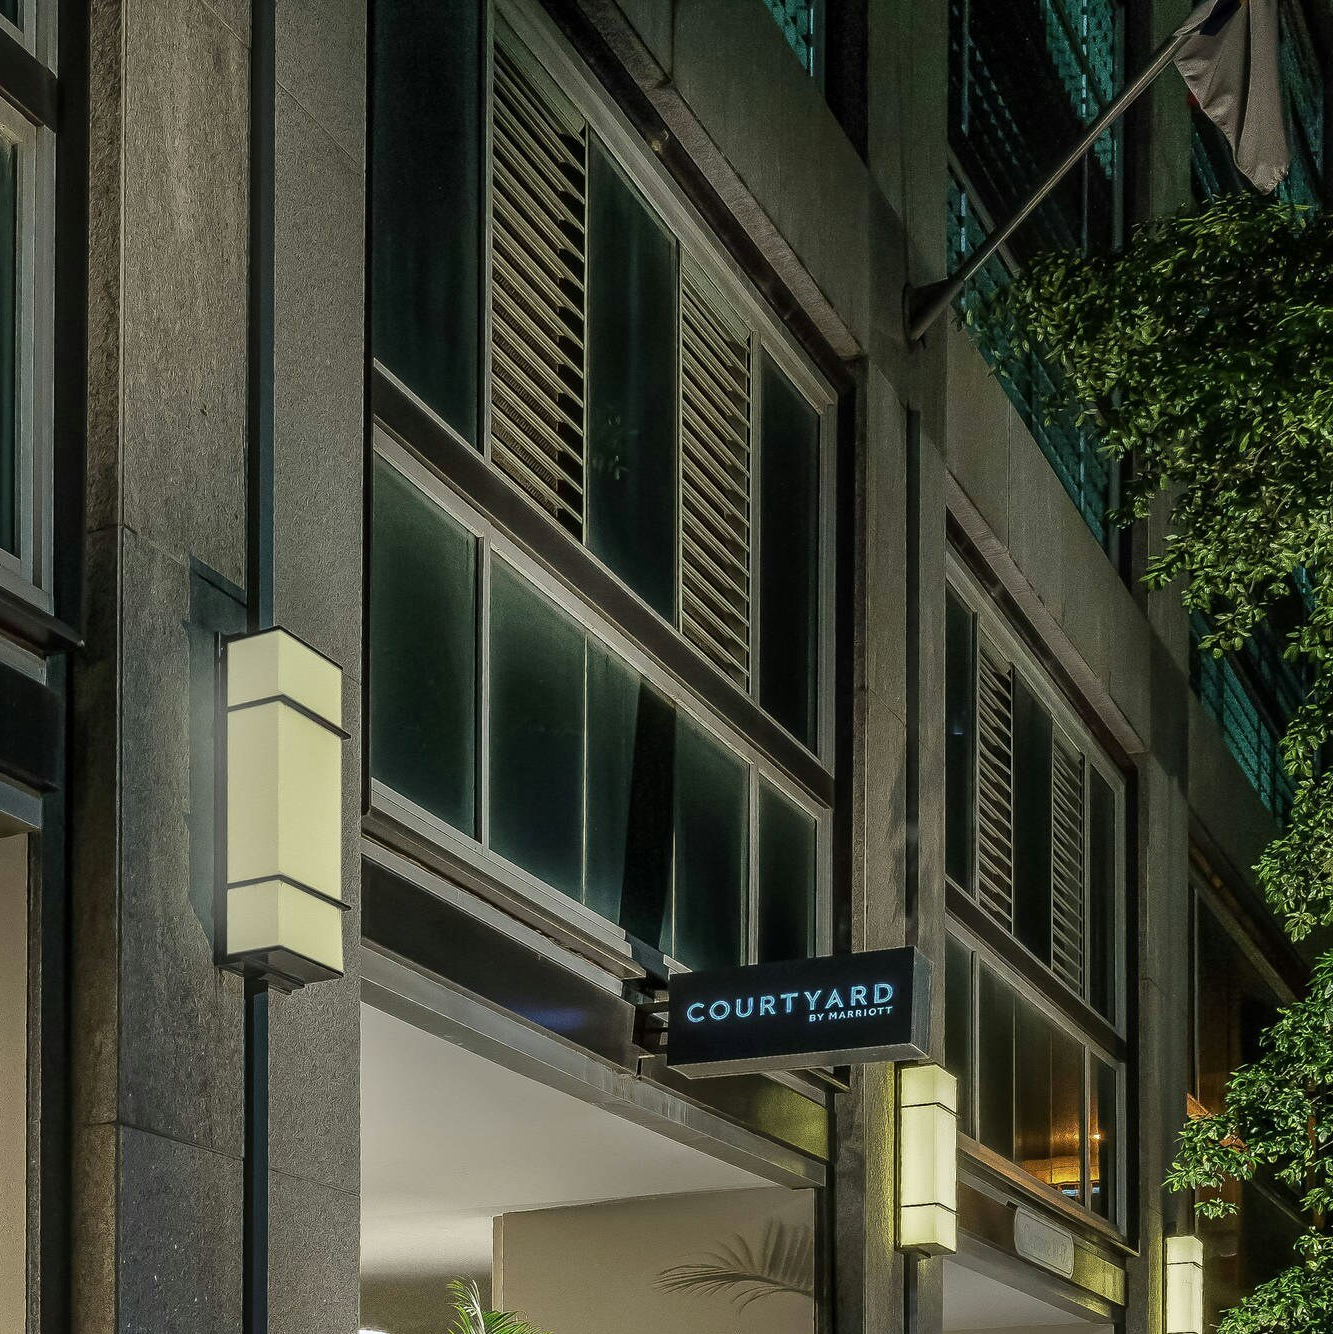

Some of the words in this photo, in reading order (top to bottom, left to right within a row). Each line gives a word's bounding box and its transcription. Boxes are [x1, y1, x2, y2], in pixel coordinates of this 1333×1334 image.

[686, 983, 894, 1023] COURTYARD
[809, 1013, 824, 1022] BY
[828, 1006, 894, 1021] MARRIOTT
